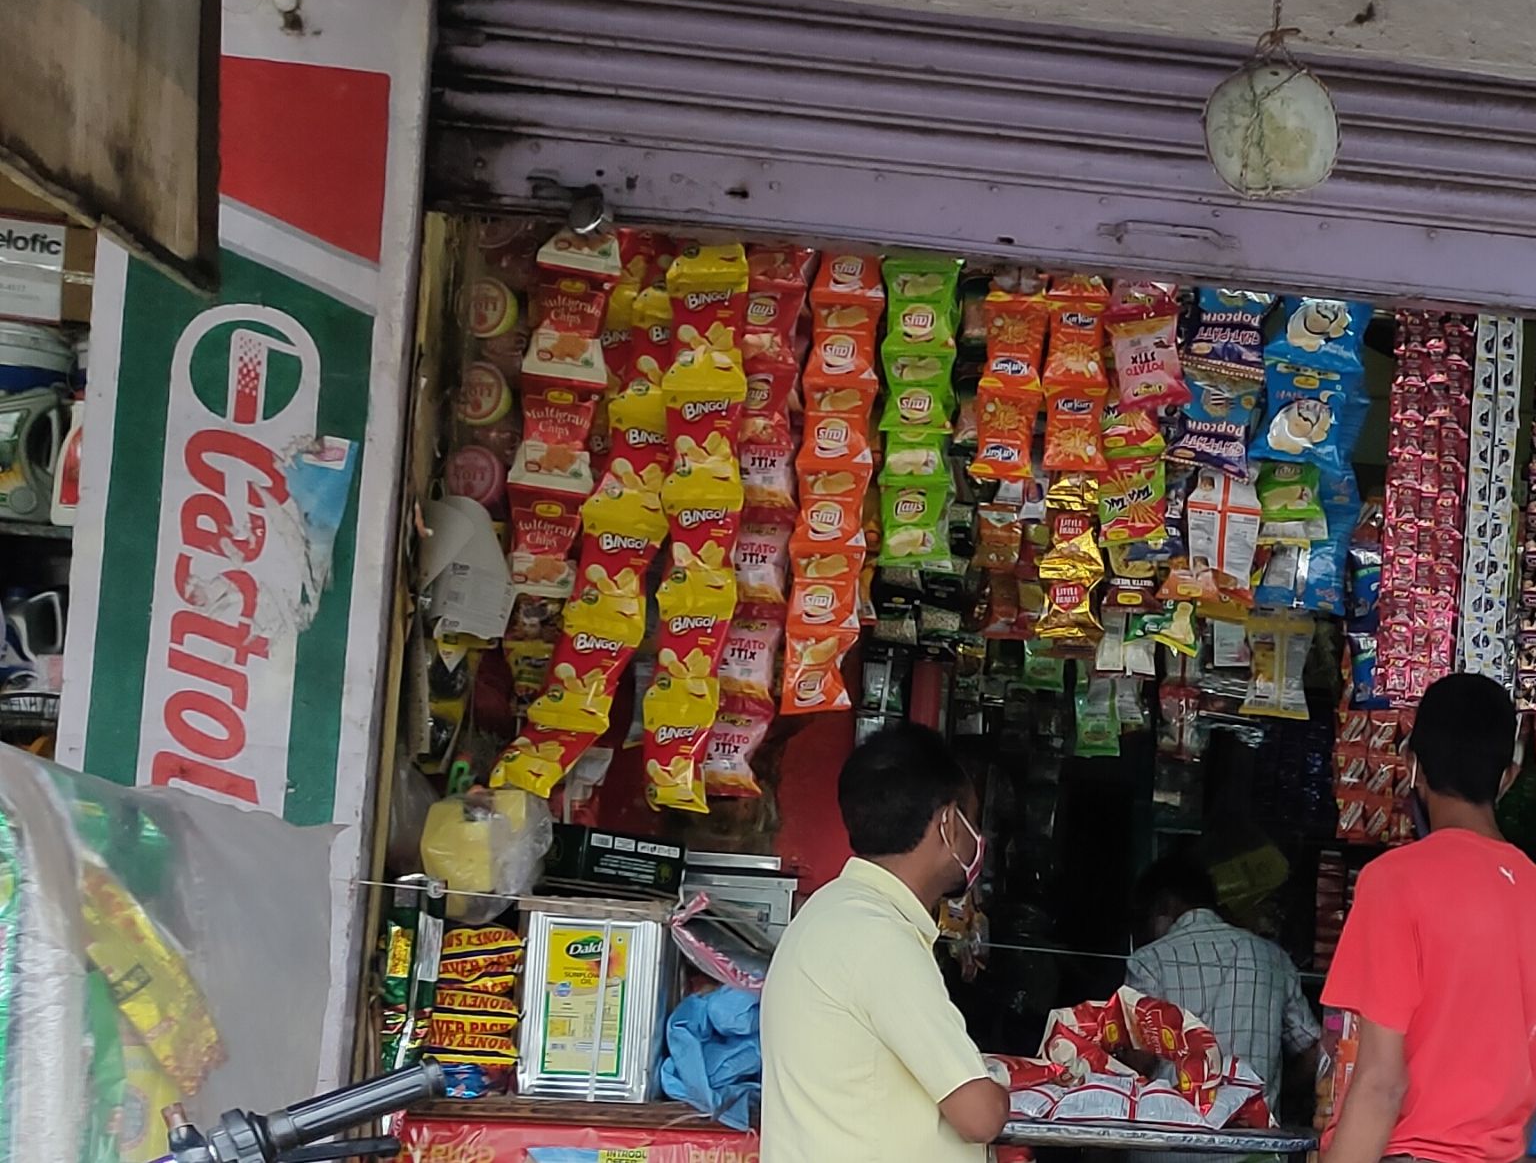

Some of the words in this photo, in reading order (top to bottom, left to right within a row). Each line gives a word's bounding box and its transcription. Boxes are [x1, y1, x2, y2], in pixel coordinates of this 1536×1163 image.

[1202, 312, 1260, 325] Popcorn
[1126, 358, 1165, 377] POTATO
[1187, 420, 1246, 436] Popcorn
[740, 541, 777, 554] OTATO
[730, 638, 766, 650] OTATO
[714, 733, 749, 745] OTATO
[461, 992, 514, 1010] MONEY
[460, 1034, 513, 1050] MONEY
